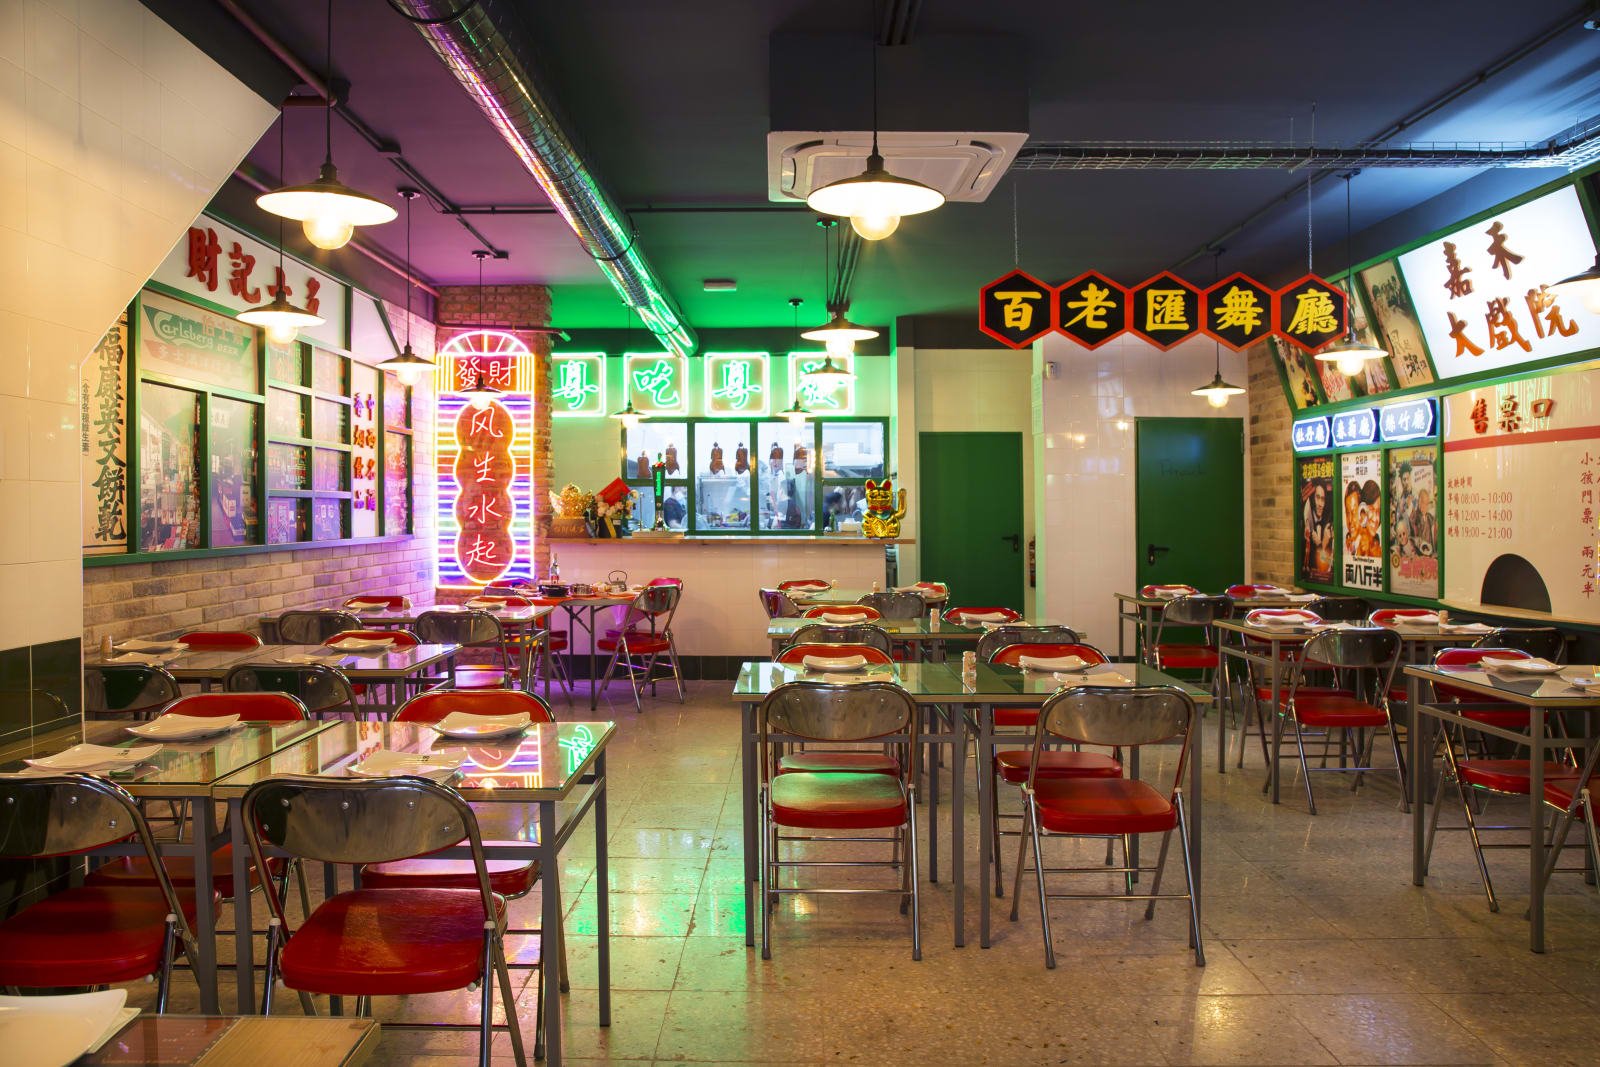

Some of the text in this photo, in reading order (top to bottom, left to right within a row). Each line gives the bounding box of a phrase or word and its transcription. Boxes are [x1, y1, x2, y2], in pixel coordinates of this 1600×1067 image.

[993, 282, 1338, 336] 百老匯舞廳
[153, 310, 214, 350] Carlsberg
[456, 357, 517, 388] 發財
[1470, 395, 1554, 434] 售票口
[466, 406, 505, 567] 风生水起
